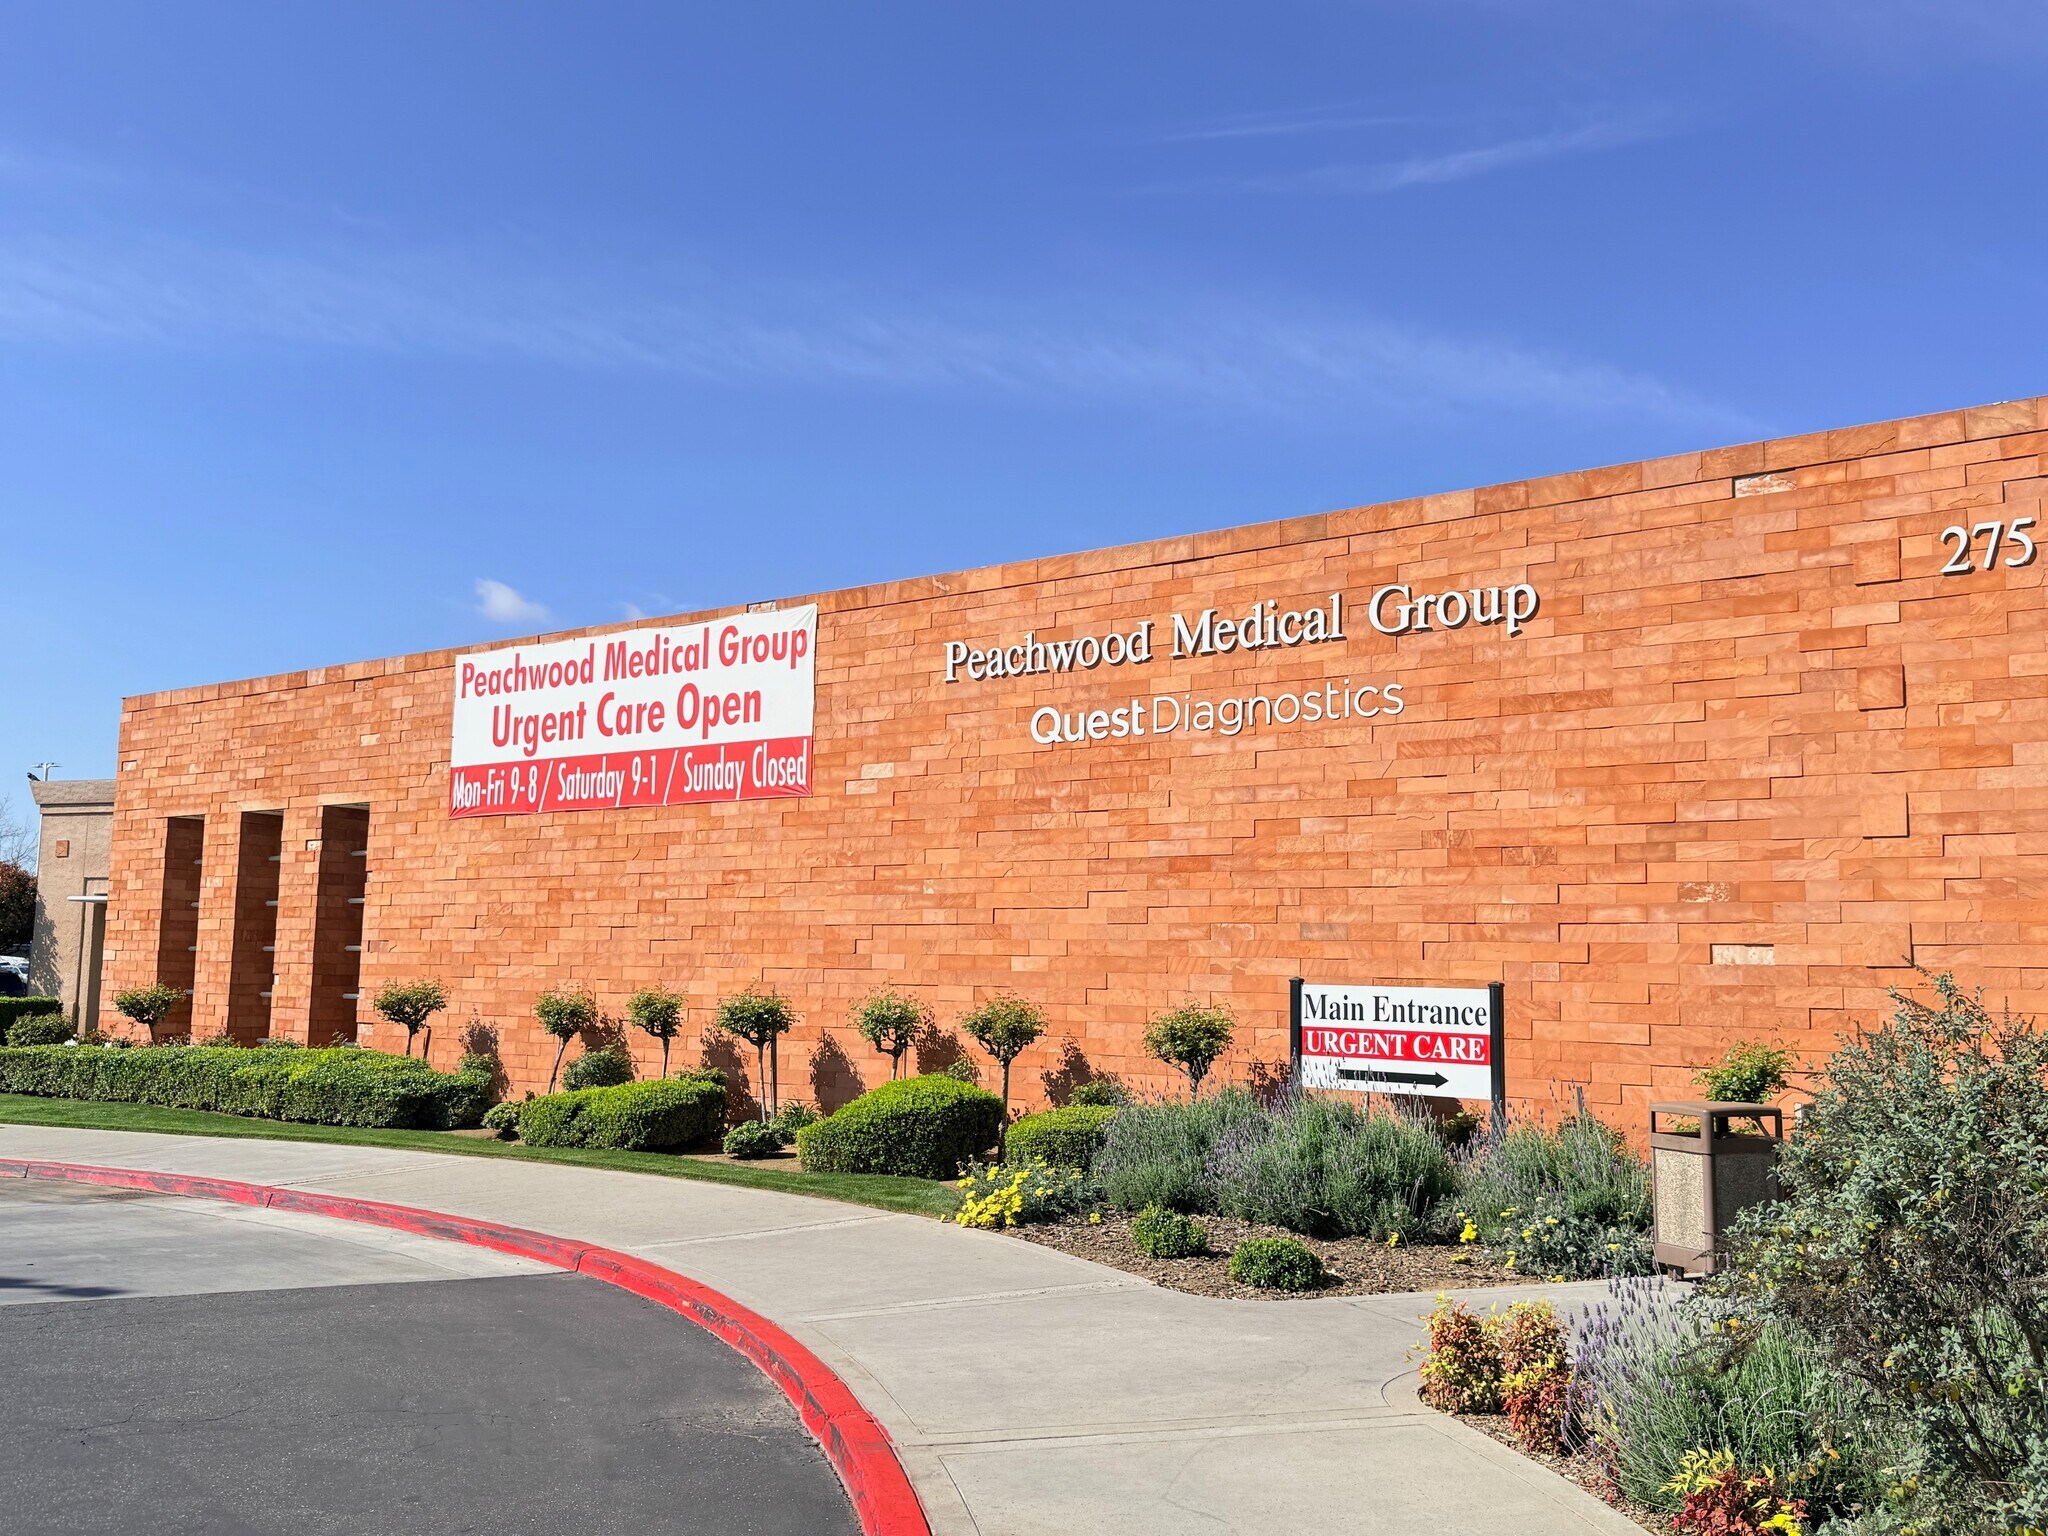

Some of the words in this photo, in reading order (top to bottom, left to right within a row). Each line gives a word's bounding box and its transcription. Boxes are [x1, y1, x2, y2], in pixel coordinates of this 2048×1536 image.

[1939, 517, 2034, 573] 275
[461, 643, 594, 699] Peachwood
[604, 627, 709, 682] Medical
[718, 625, 807, 669] Group
[943, 621, 1153, 682] Peachwood
[1169, 591, 1345, 660] Medical
[1368, 582, 1539, 635] Group
[492, 701, 587, 756] Urgent
[597, 692, 665, 737] Care
[677, 683, 761, 739] Open
[453, 767, 505, 809] Mon-Fri
[510, 764, 538, 804] 9-8
[558, 755, 625, 807] Saturday
[631, 755, 657, 796] 9-1
[683, 746, 745, 800] Sunday
[752, 739, 808, 788] Closed
[1304, 994, 1364, 1021] Main
[1373, 995, 1487, 1026] Entrance
[1305, 1030, 1407, 1057] URGENT
[1413, 1035, 1485, 1061] CARE
